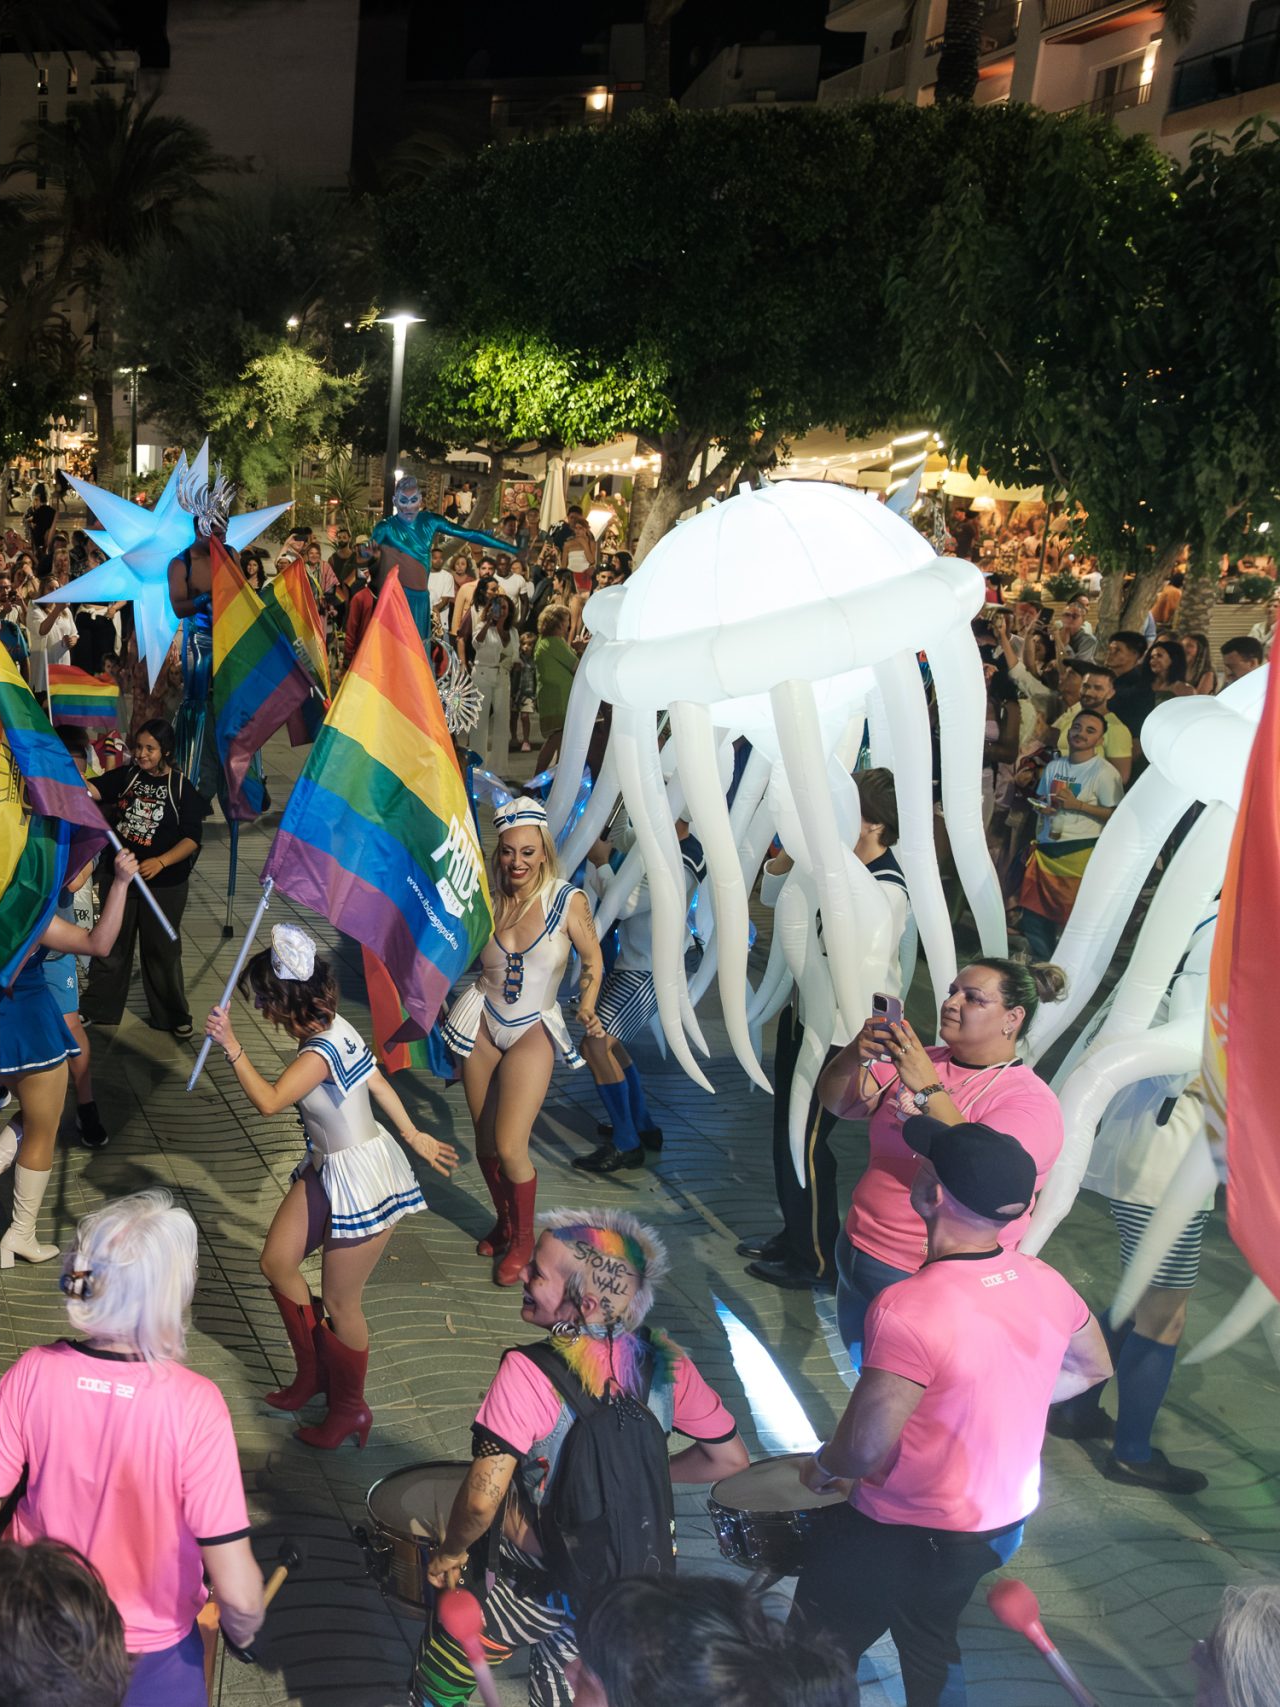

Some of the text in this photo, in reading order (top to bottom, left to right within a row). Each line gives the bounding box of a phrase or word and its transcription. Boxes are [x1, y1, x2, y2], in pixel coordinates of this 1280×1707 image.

[430, 813, 483, 914] PRIDE
[592, 1271, 630, 1296] WALL
[76, 1376, 135, 1399] CODE 22
